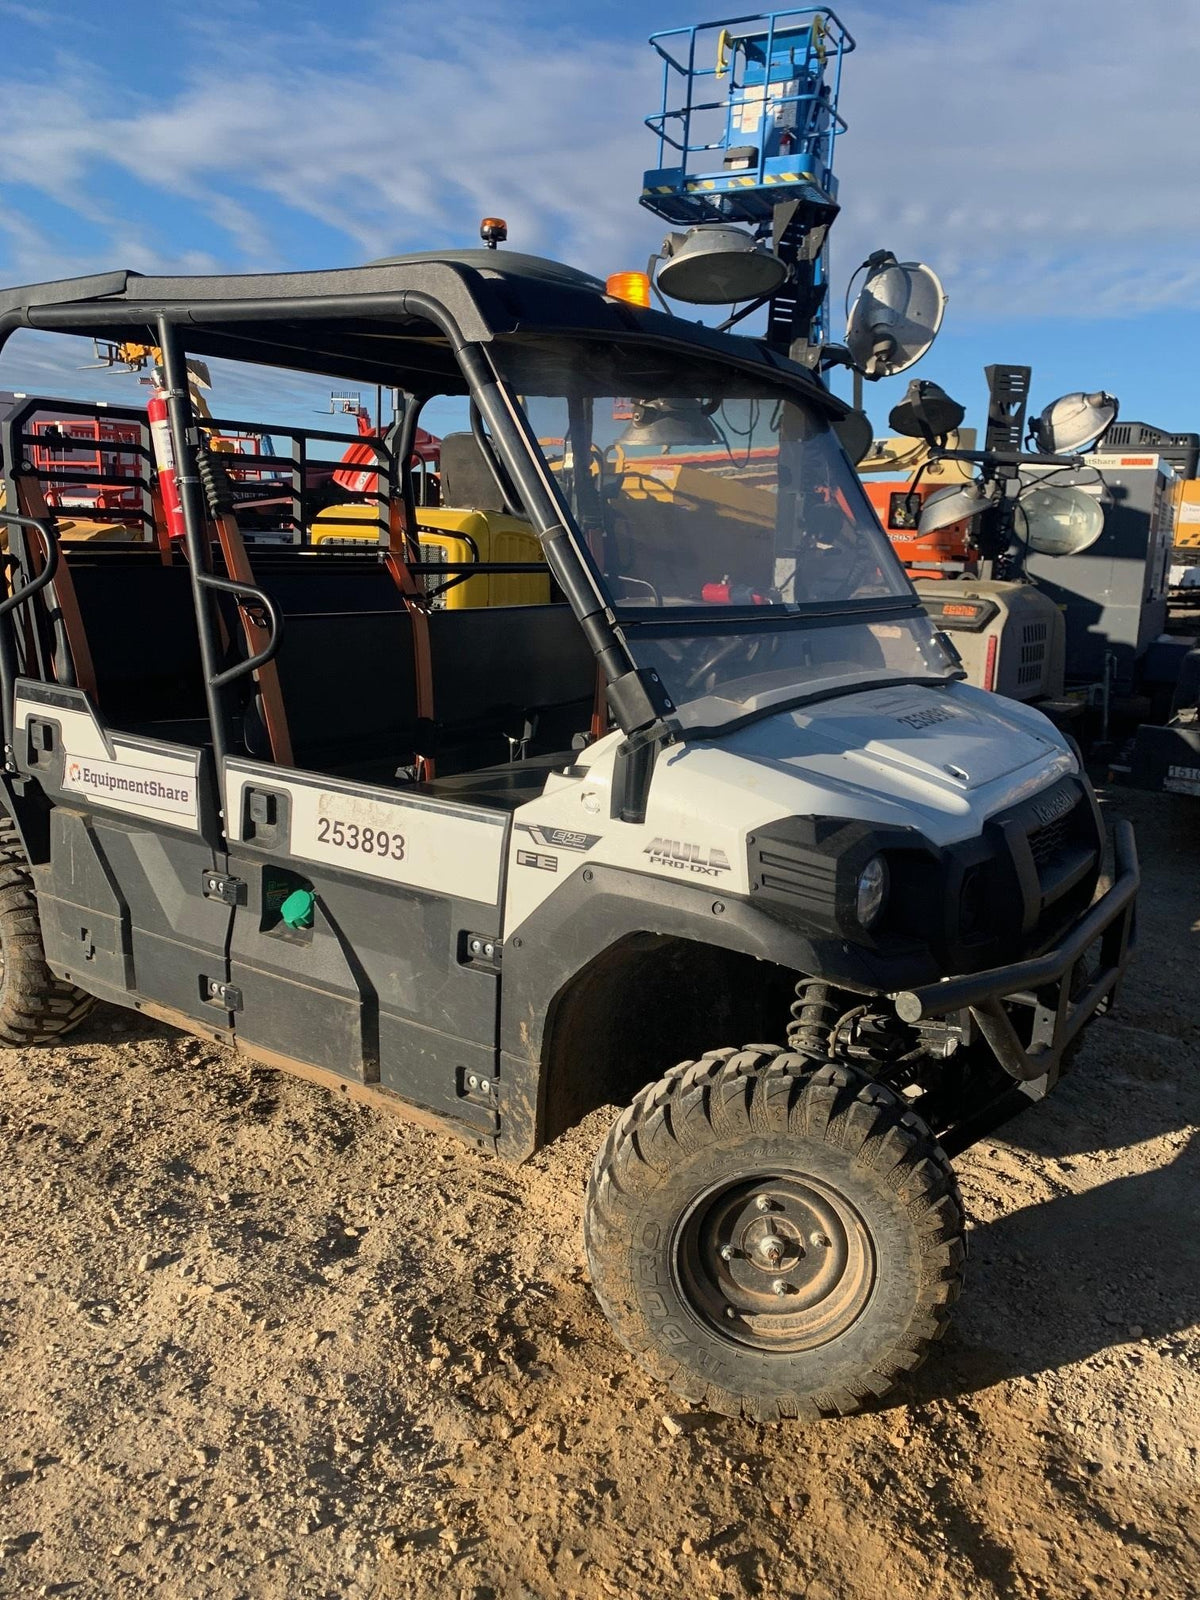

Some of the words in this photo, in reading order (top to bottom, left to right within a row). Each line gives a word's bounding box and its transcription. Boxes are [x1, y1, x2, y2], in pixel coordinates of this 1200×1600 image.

[83, 767, 189, 803] EquipmentShare
[317, 817, 405, 861] 253893
[642, 837, 732, 871] MULE
[517, 850, 558, 872] FE
[649, 856, 724, 877] PRO-DXT
